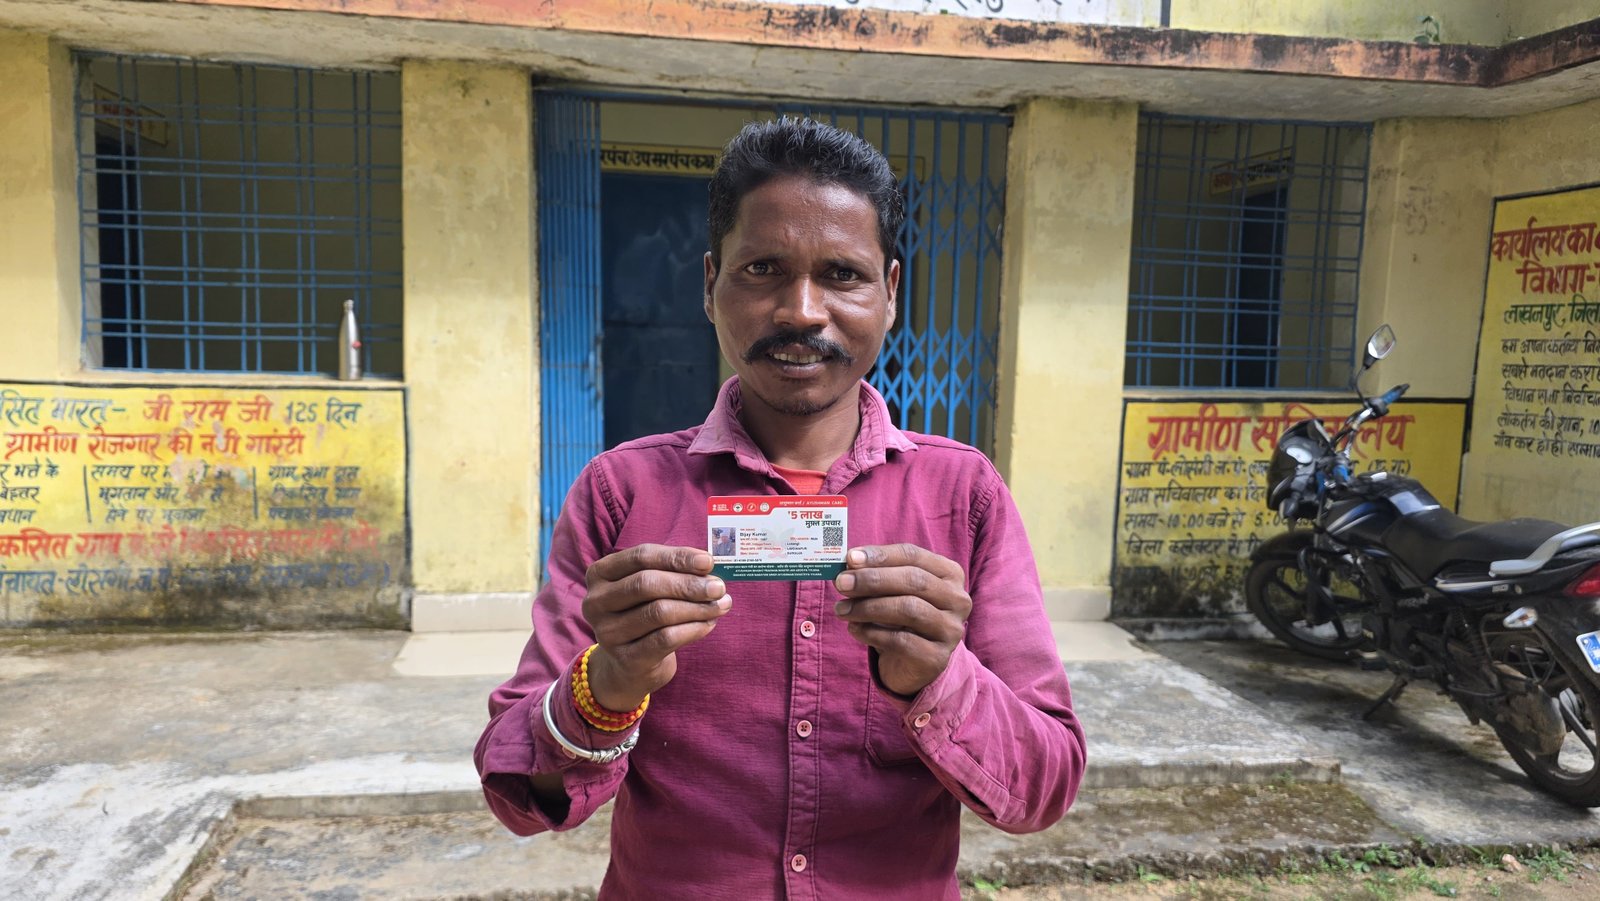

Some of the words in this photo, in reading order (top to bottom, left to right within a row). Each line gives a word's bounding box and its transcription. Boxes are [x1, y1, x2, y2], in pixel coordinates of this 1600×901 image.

[1491, 216, 1570, 262] कार्यालय
[143, 394, 174, 421] जी
[182, 399, 231, 427] राम
[237, 395, 273, 422] जी
[285, 401, 318, 423] 125
[325, 396, 362, 429] दिन
[4, 425, 80, 460] ग्रामीण
[88, 425, 166, 460] रोजगार
[246, 428, 305, 455] गारंटी
[1148, 402, 1251, 460] ग्रामीण
[91, 464, 135, 480] समय
[140, 464, 158, 481] पर
[1154, 479, 1221, 505] सचिवालय
[799, 510, 823, 519] लाख
[1125, 532, 1164, 555] जिला
